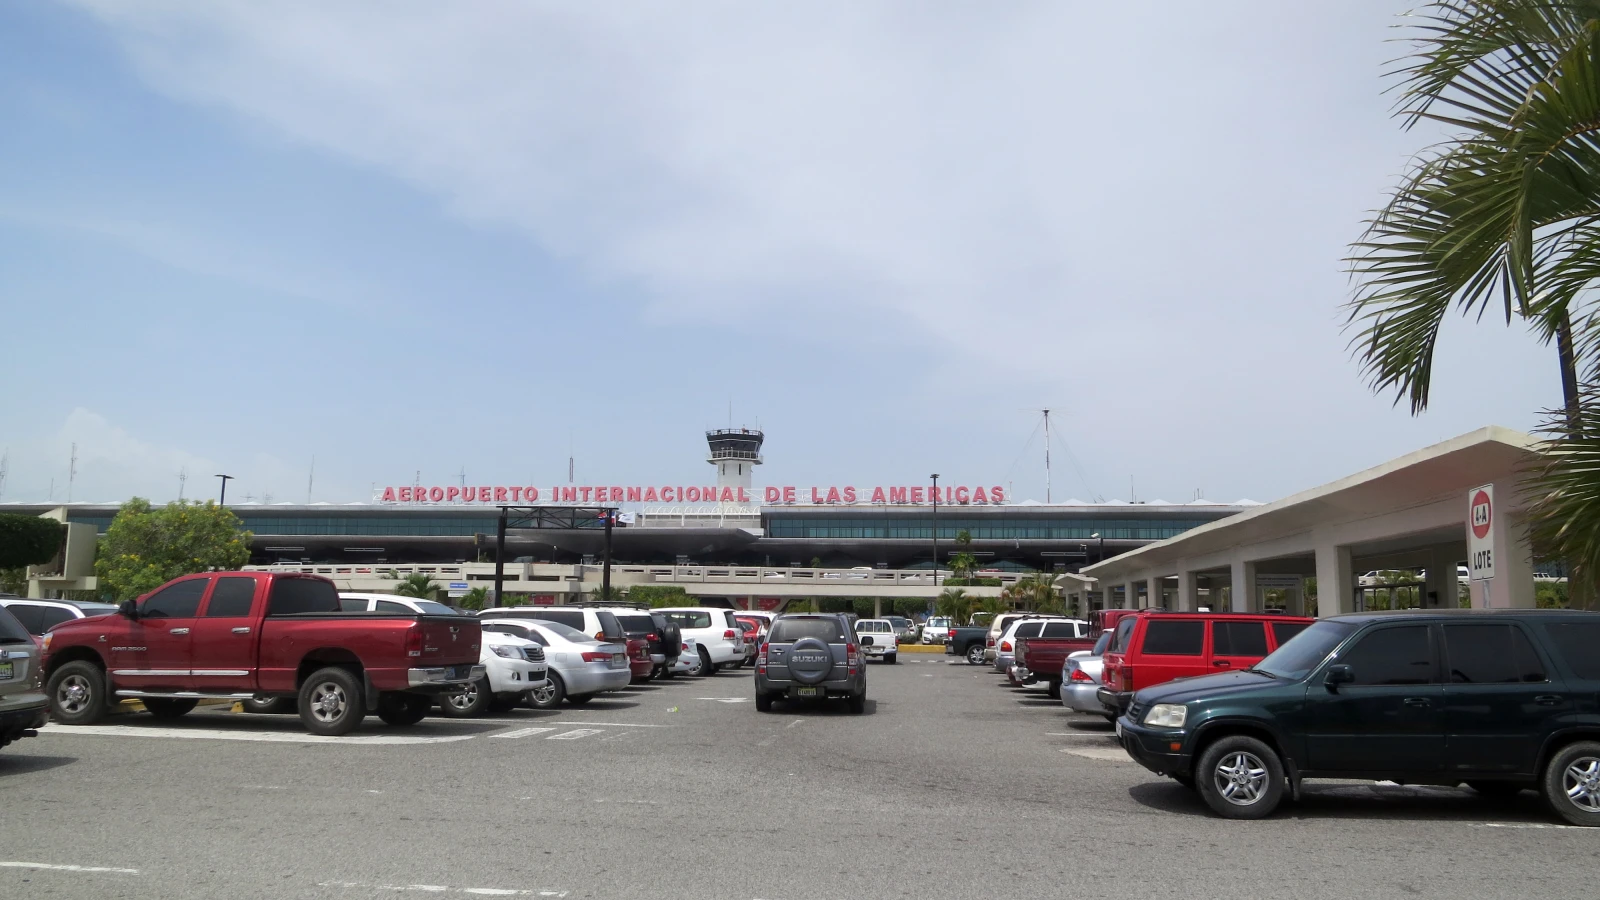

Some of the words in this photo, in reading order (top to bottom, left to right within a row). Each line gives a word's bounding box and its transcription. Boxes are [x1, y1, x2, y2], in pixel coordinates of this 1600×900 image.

[382, 486, 539, 502] AEROPUERTO
[552, 486, 750, 502] INTERNACIONAL
[765, 486, 796, 502] DE
[811, 486, 857, 502] LAS
[871, 486, 1005, 502] AMERICAS
[1473, 550, 1492, 571] LOTE
[791, 655, 828, 663] SUZUKI
